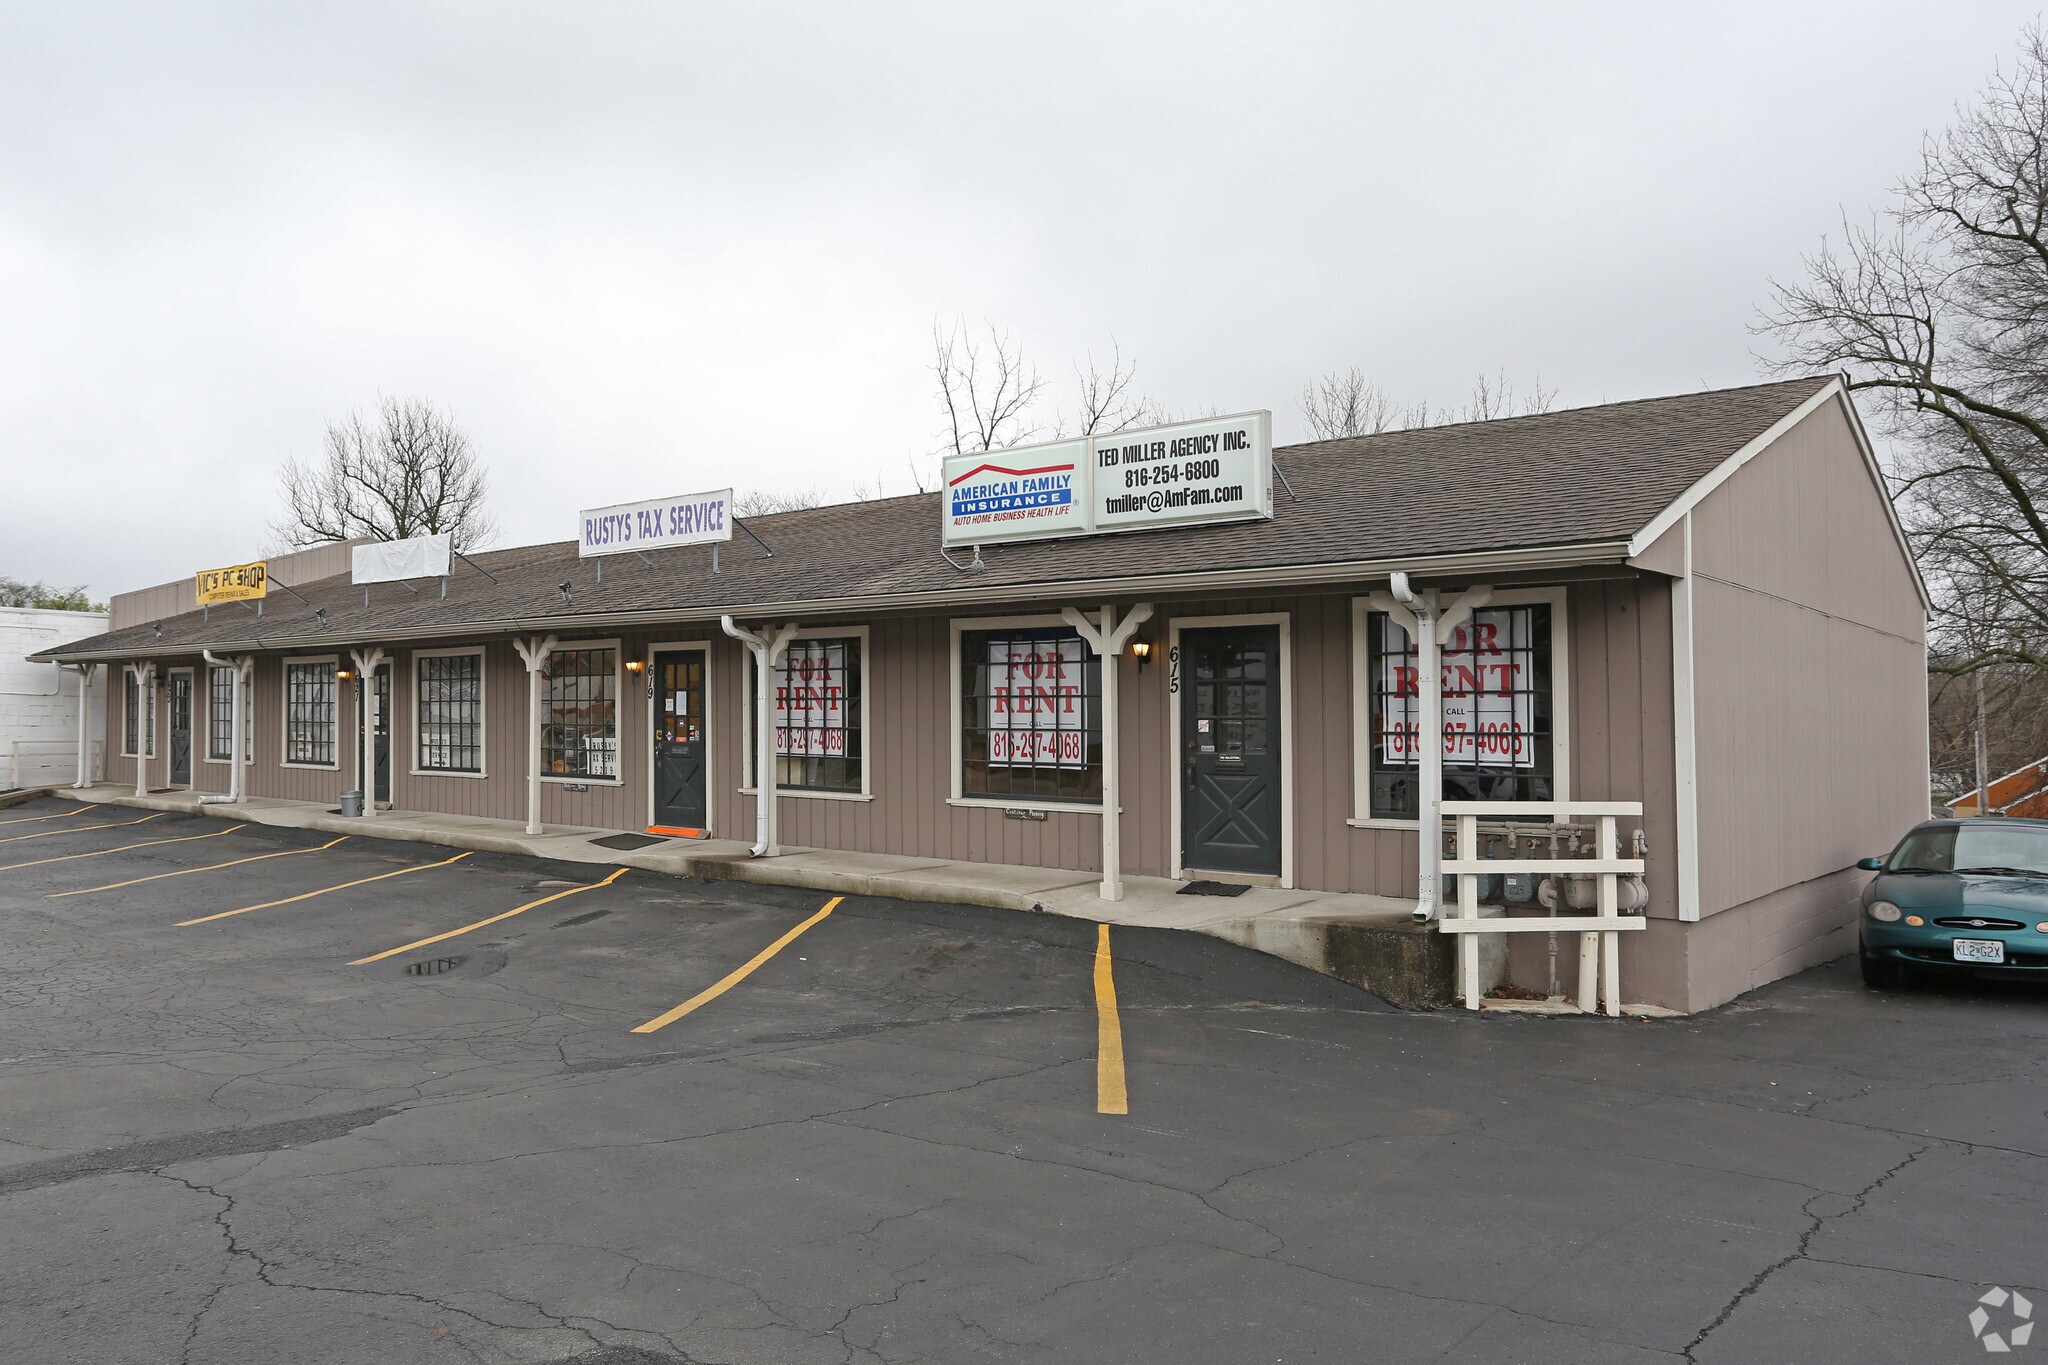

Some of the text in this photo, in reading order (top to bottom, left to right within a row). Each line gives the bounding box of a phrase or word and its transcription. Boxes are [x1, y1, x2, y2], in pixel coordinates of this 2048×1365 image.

[1097, 430, 1251, 468] TED MILLER AGENCY INC.
[1125, 458, 1220, 488] 816-254-6800
[953, 474, 1071, 502] AMERICAN FAMILY
[961, 492, 1061, 513] INSURANCE
[1106, 484, 1243, 514] tmiller@AmFam.com
[586, 500, 724, 546] RUSTYS TAX SERVICE
[953, 504, 1071, 526] AUTO HOME BUSINESS HEALTH LIFE
[197, 566, 265, 597] VIC'S PC SHOP
[1409, 622, 1503, 658] OR
[785, 656, 832, 682] FOR
[1005, 652, 1067, 680] FOR
[1169, 646, 1179, 694] 615
[1393, 663, 1521, 699] RENT
[776, 686, 842, 711] RENT
[994, 685, 1079, 714] RENT
[1446, 708, 1465, 716] CALL
[1393, 721, 1523, 756] 81697-4068
[1955, 943, 2001, 958] KL2 G2X
